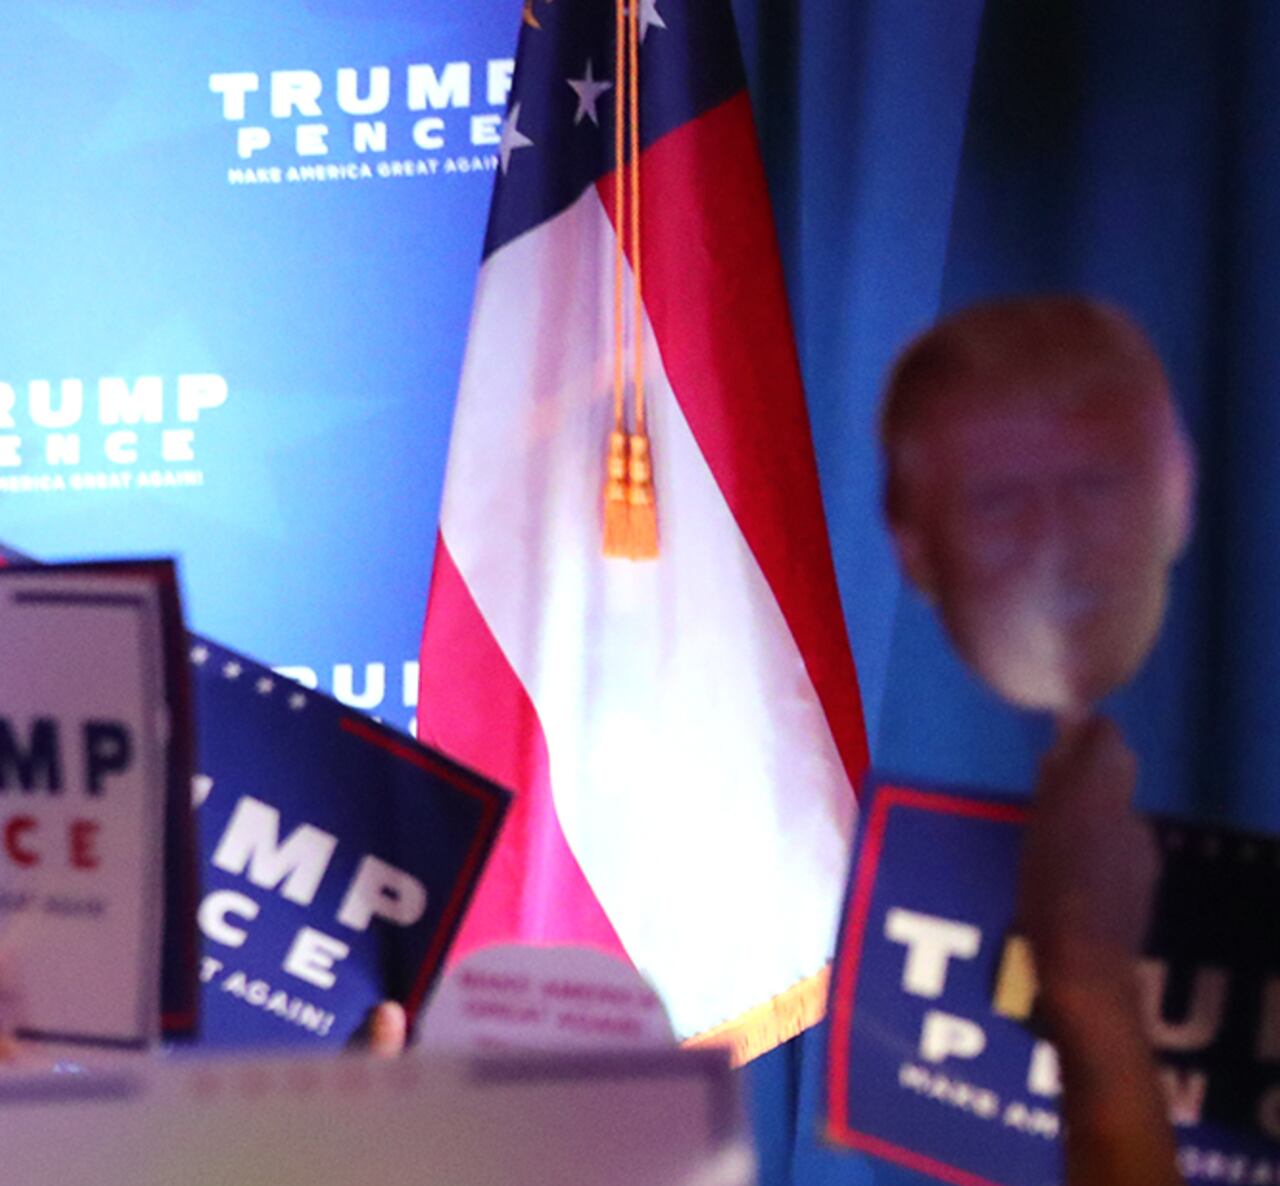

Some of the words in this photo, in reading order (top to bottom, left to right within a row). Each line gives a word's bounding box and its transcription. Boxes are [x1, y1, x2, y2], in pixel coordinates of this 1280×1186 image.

[237, 114, 502, 158] PENCE
[227, 166, 281, 184] MAKE
[285, 162, 372, 181] AMERICA
[378, 159, 439, 177] GREAT
